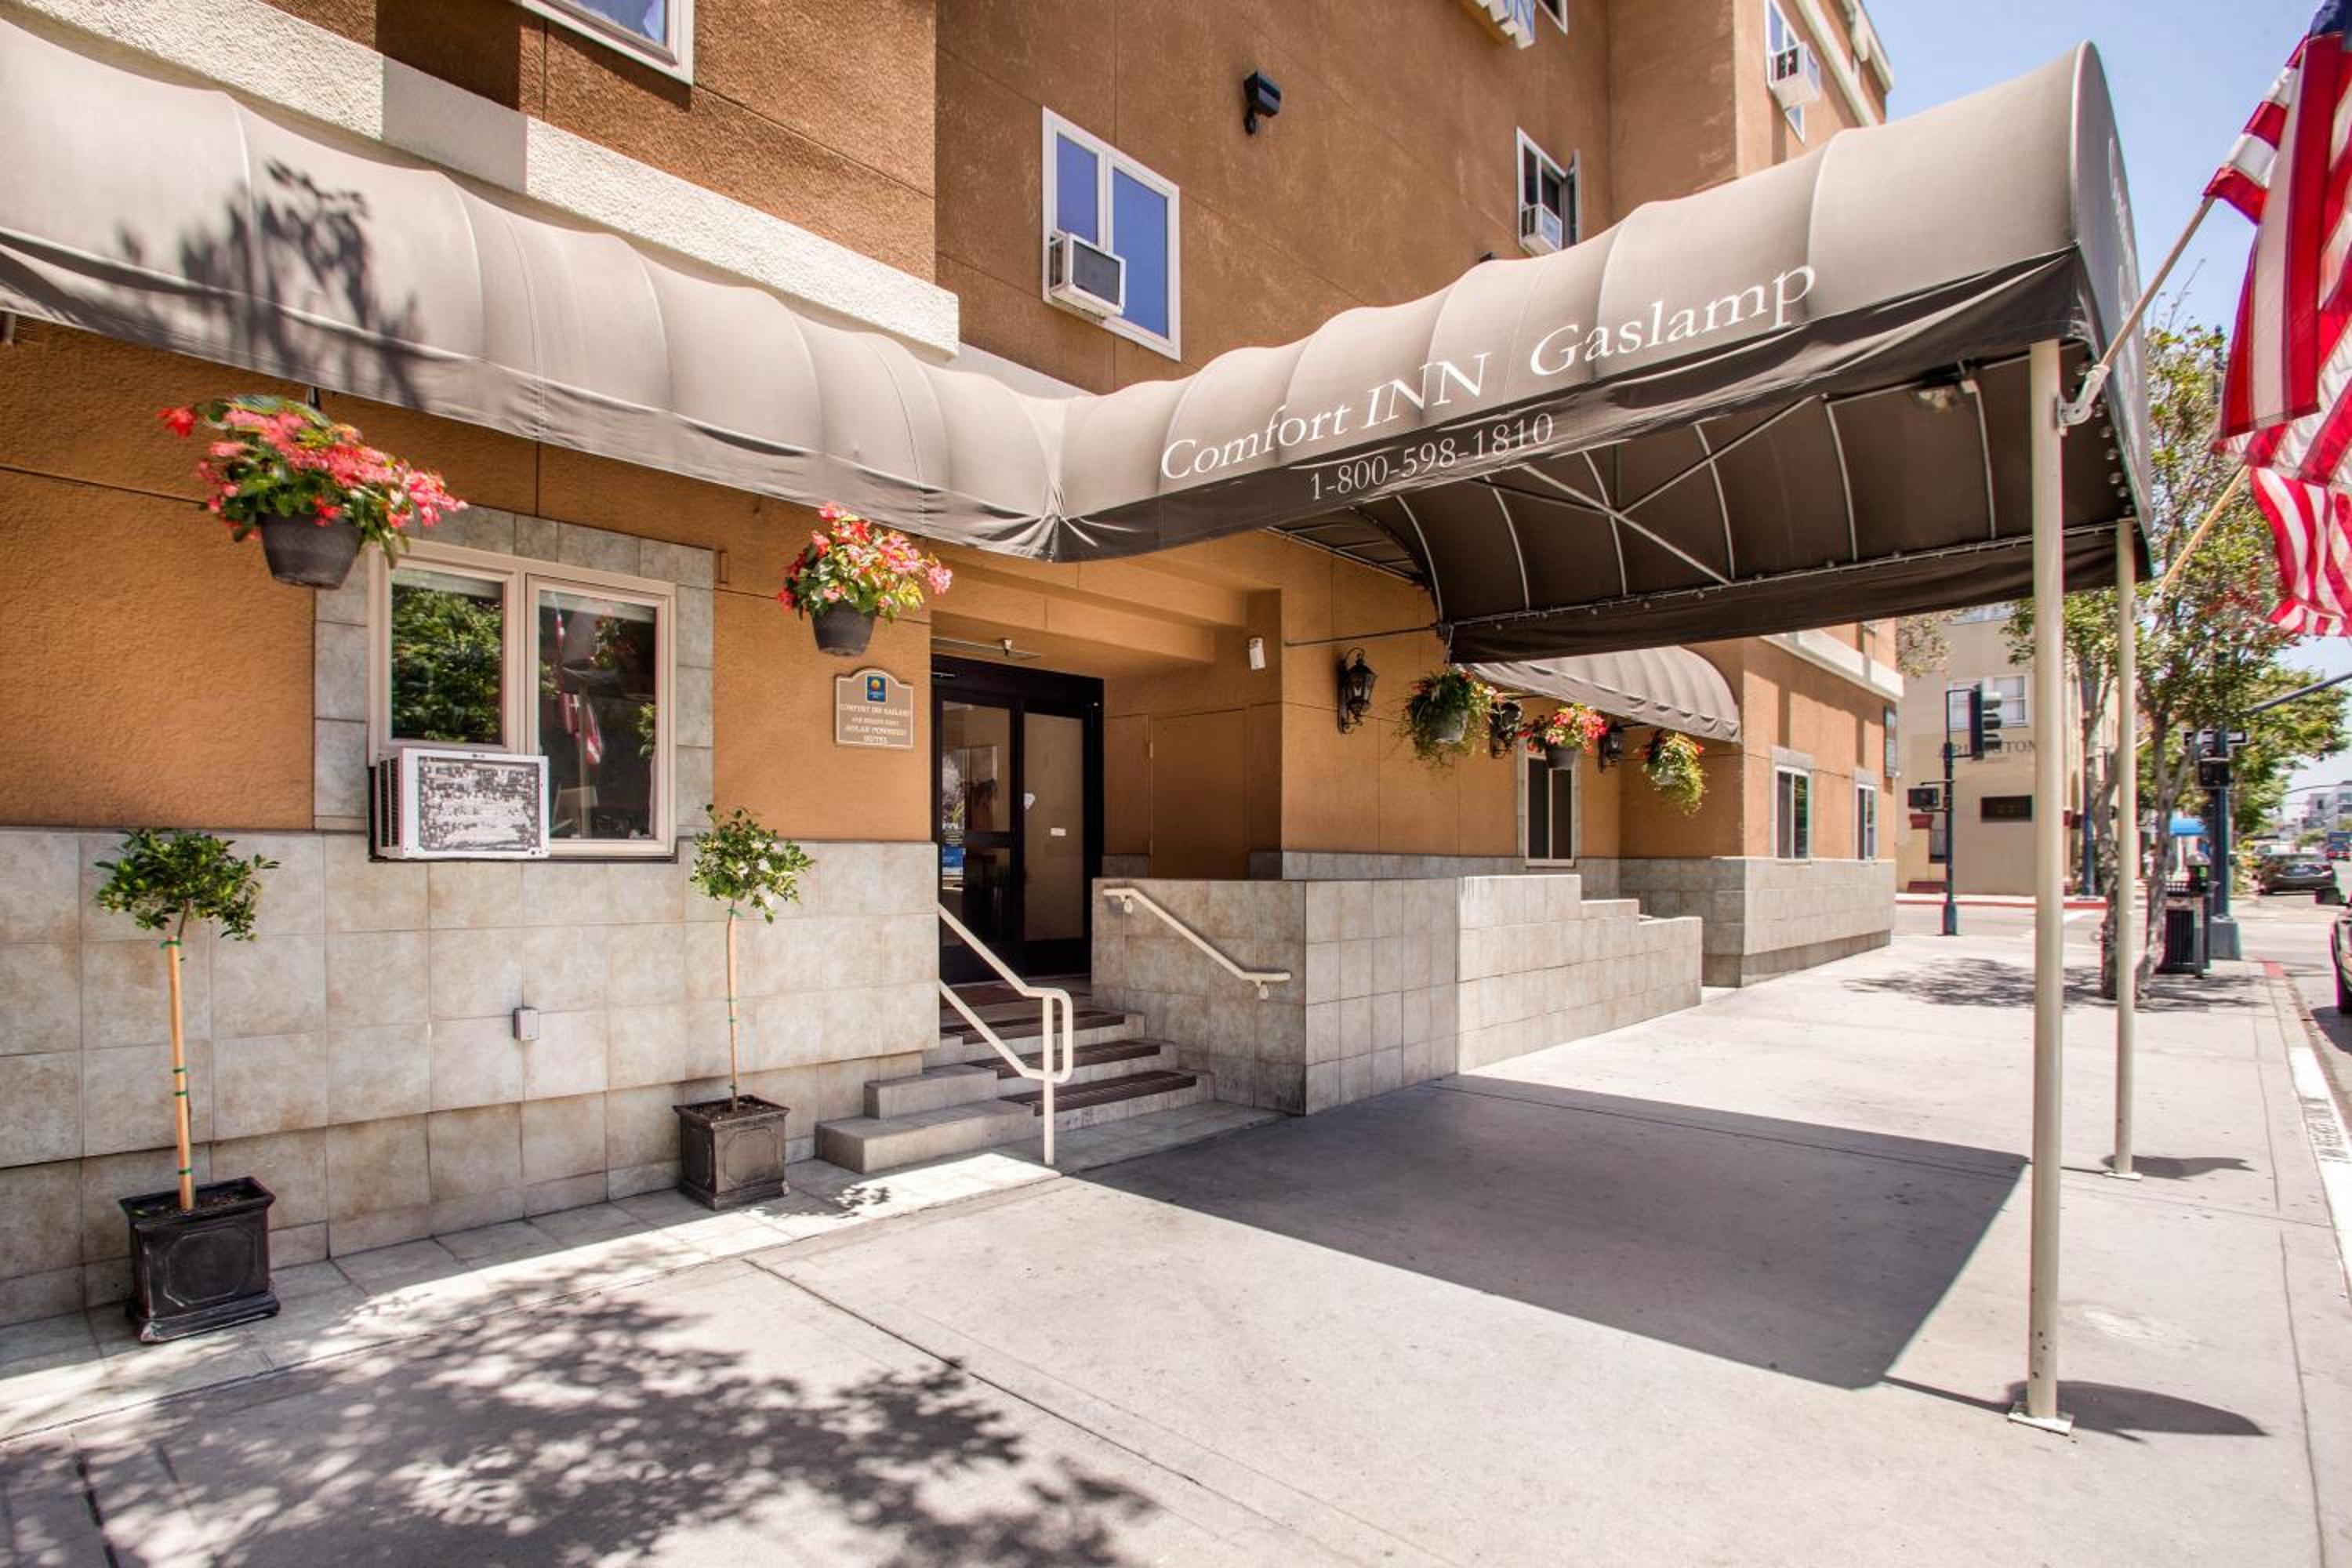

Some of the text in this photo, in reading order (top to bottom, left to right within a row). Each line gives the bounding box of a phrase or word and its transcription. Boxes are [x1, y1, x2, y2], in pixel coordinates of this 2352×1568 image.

[1160, 264, 1816, 480] Comfort INN Gaslamp
[1308, 412, 1555, 501] 1-800-598-1810
